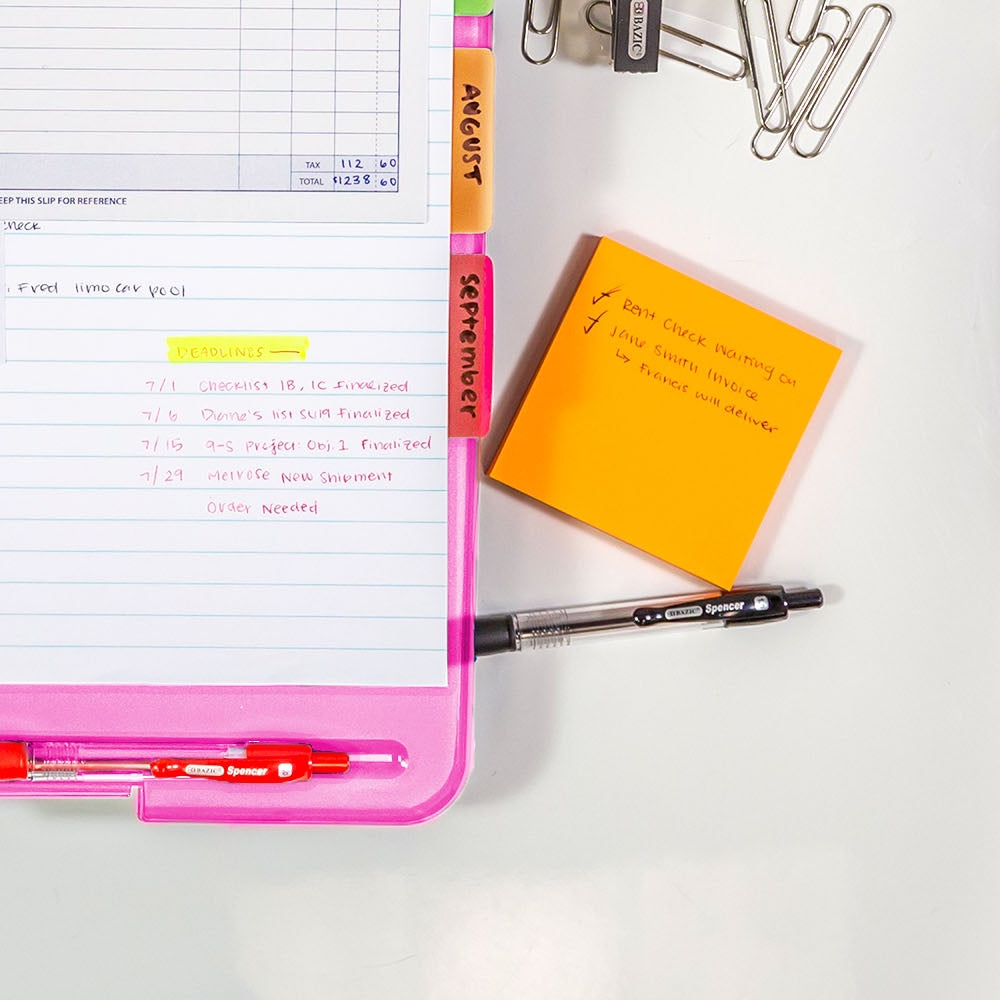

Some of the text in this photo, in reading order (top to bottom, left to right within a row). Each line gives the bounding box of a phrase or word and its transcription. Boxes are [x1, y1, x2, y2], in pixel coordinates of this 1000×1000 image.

[632, 17, 644, 52] BAZIC
[460, 84, 482, 185] AUGUST
[341, 158, 363, 169] 112
[299, 178, 324, 186] TOTAL
[333, 175, 371, 185] $1238
[16, 197, 35, 205] THIS
[37, 197, 55, 205] SLIP
[58, 197, 76, 205] FOR
[78, 197, 127, 205] REFERENCE
[623, 298, 707, 347] Rent Check
[610, 326, 647, 348] Jane
[655, 345, 699, 373] Smith
[695, 391, 720, 408] will
[705, 601, 745, 615] Spencer
[227, 765, 268, 777] Spencer
